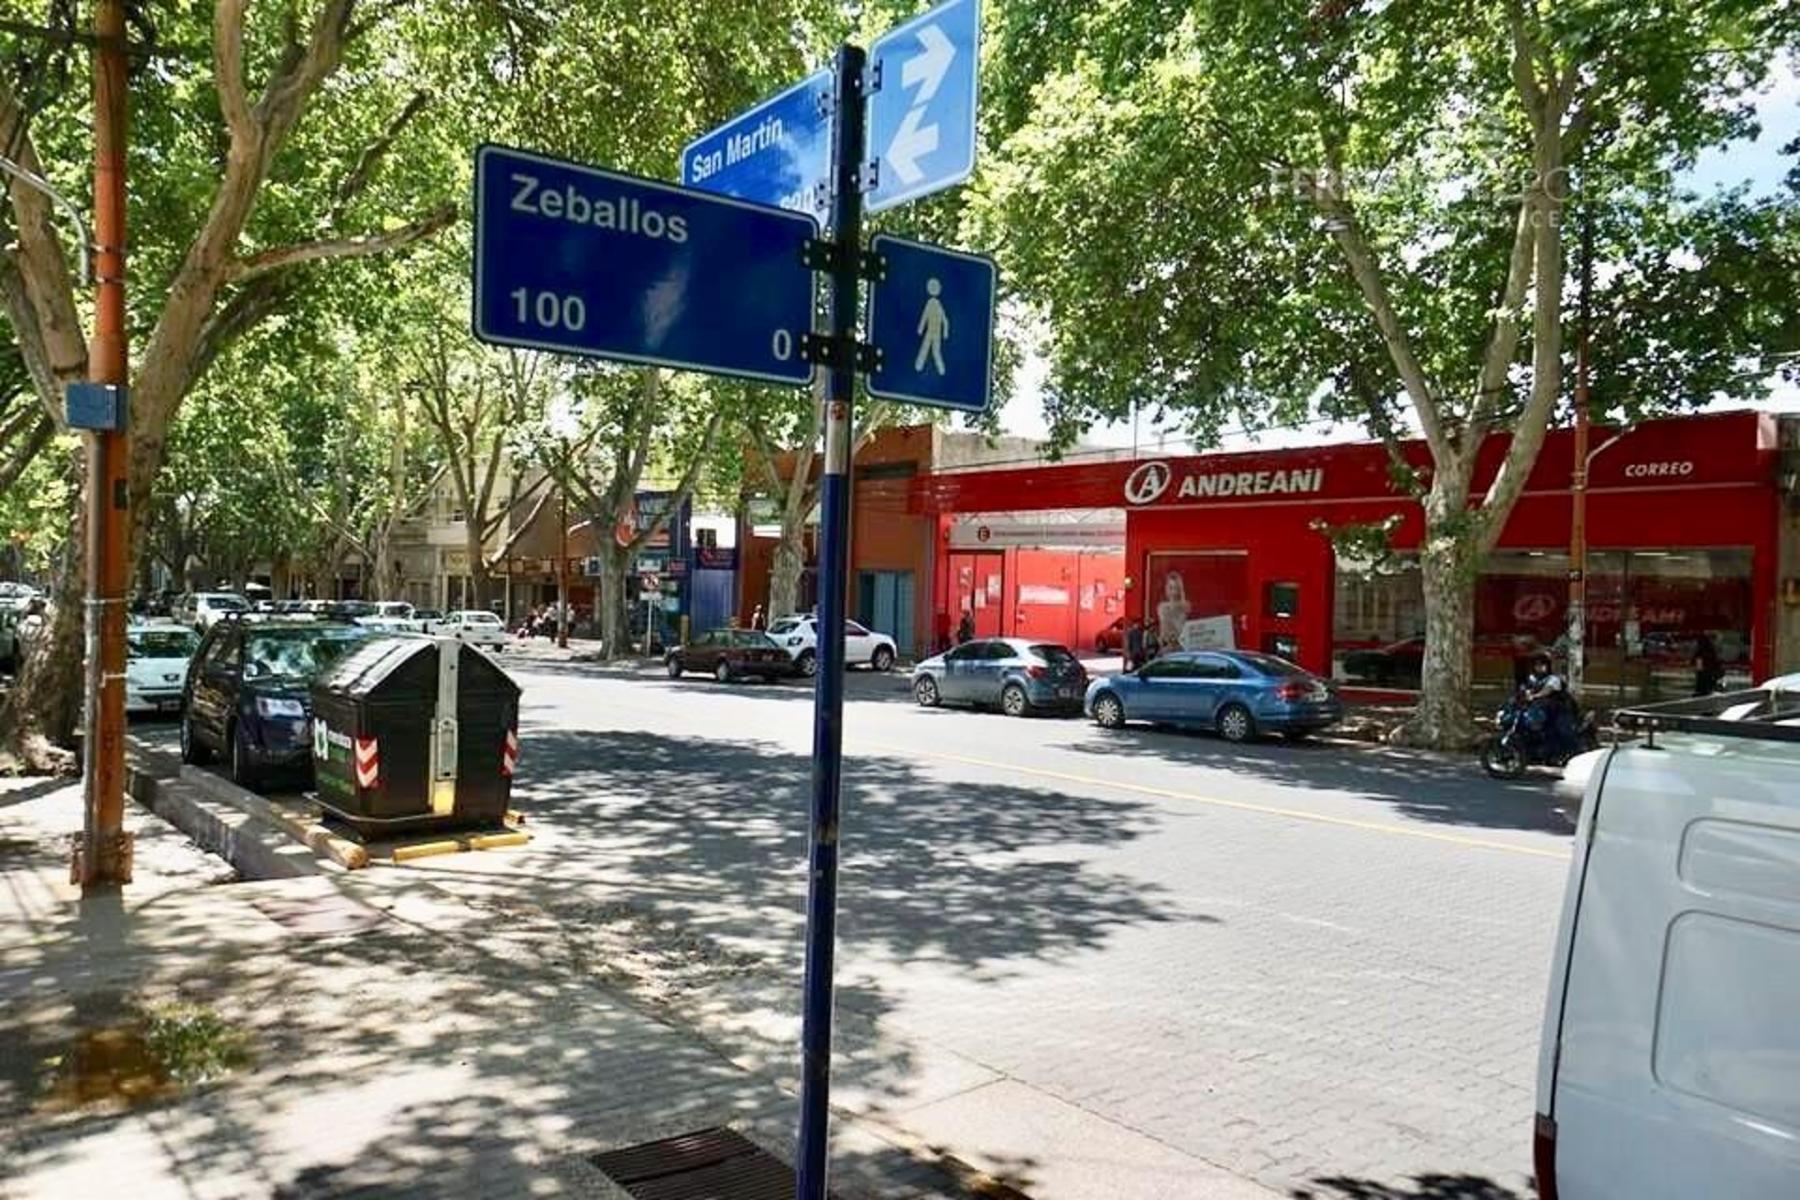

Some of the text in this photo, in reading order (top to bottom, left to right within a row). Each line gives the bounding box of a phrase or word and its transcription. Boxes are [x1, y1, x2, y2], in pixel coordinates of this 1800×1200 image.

[691, 149, 722, 183] San
[510, 172, 689, 243] Zeballos
[510, 286, 793, 361] 100 0
[1177, 468, 1324, 498] ANDREANI
[1624, 461, 1694, 477] CORREO
